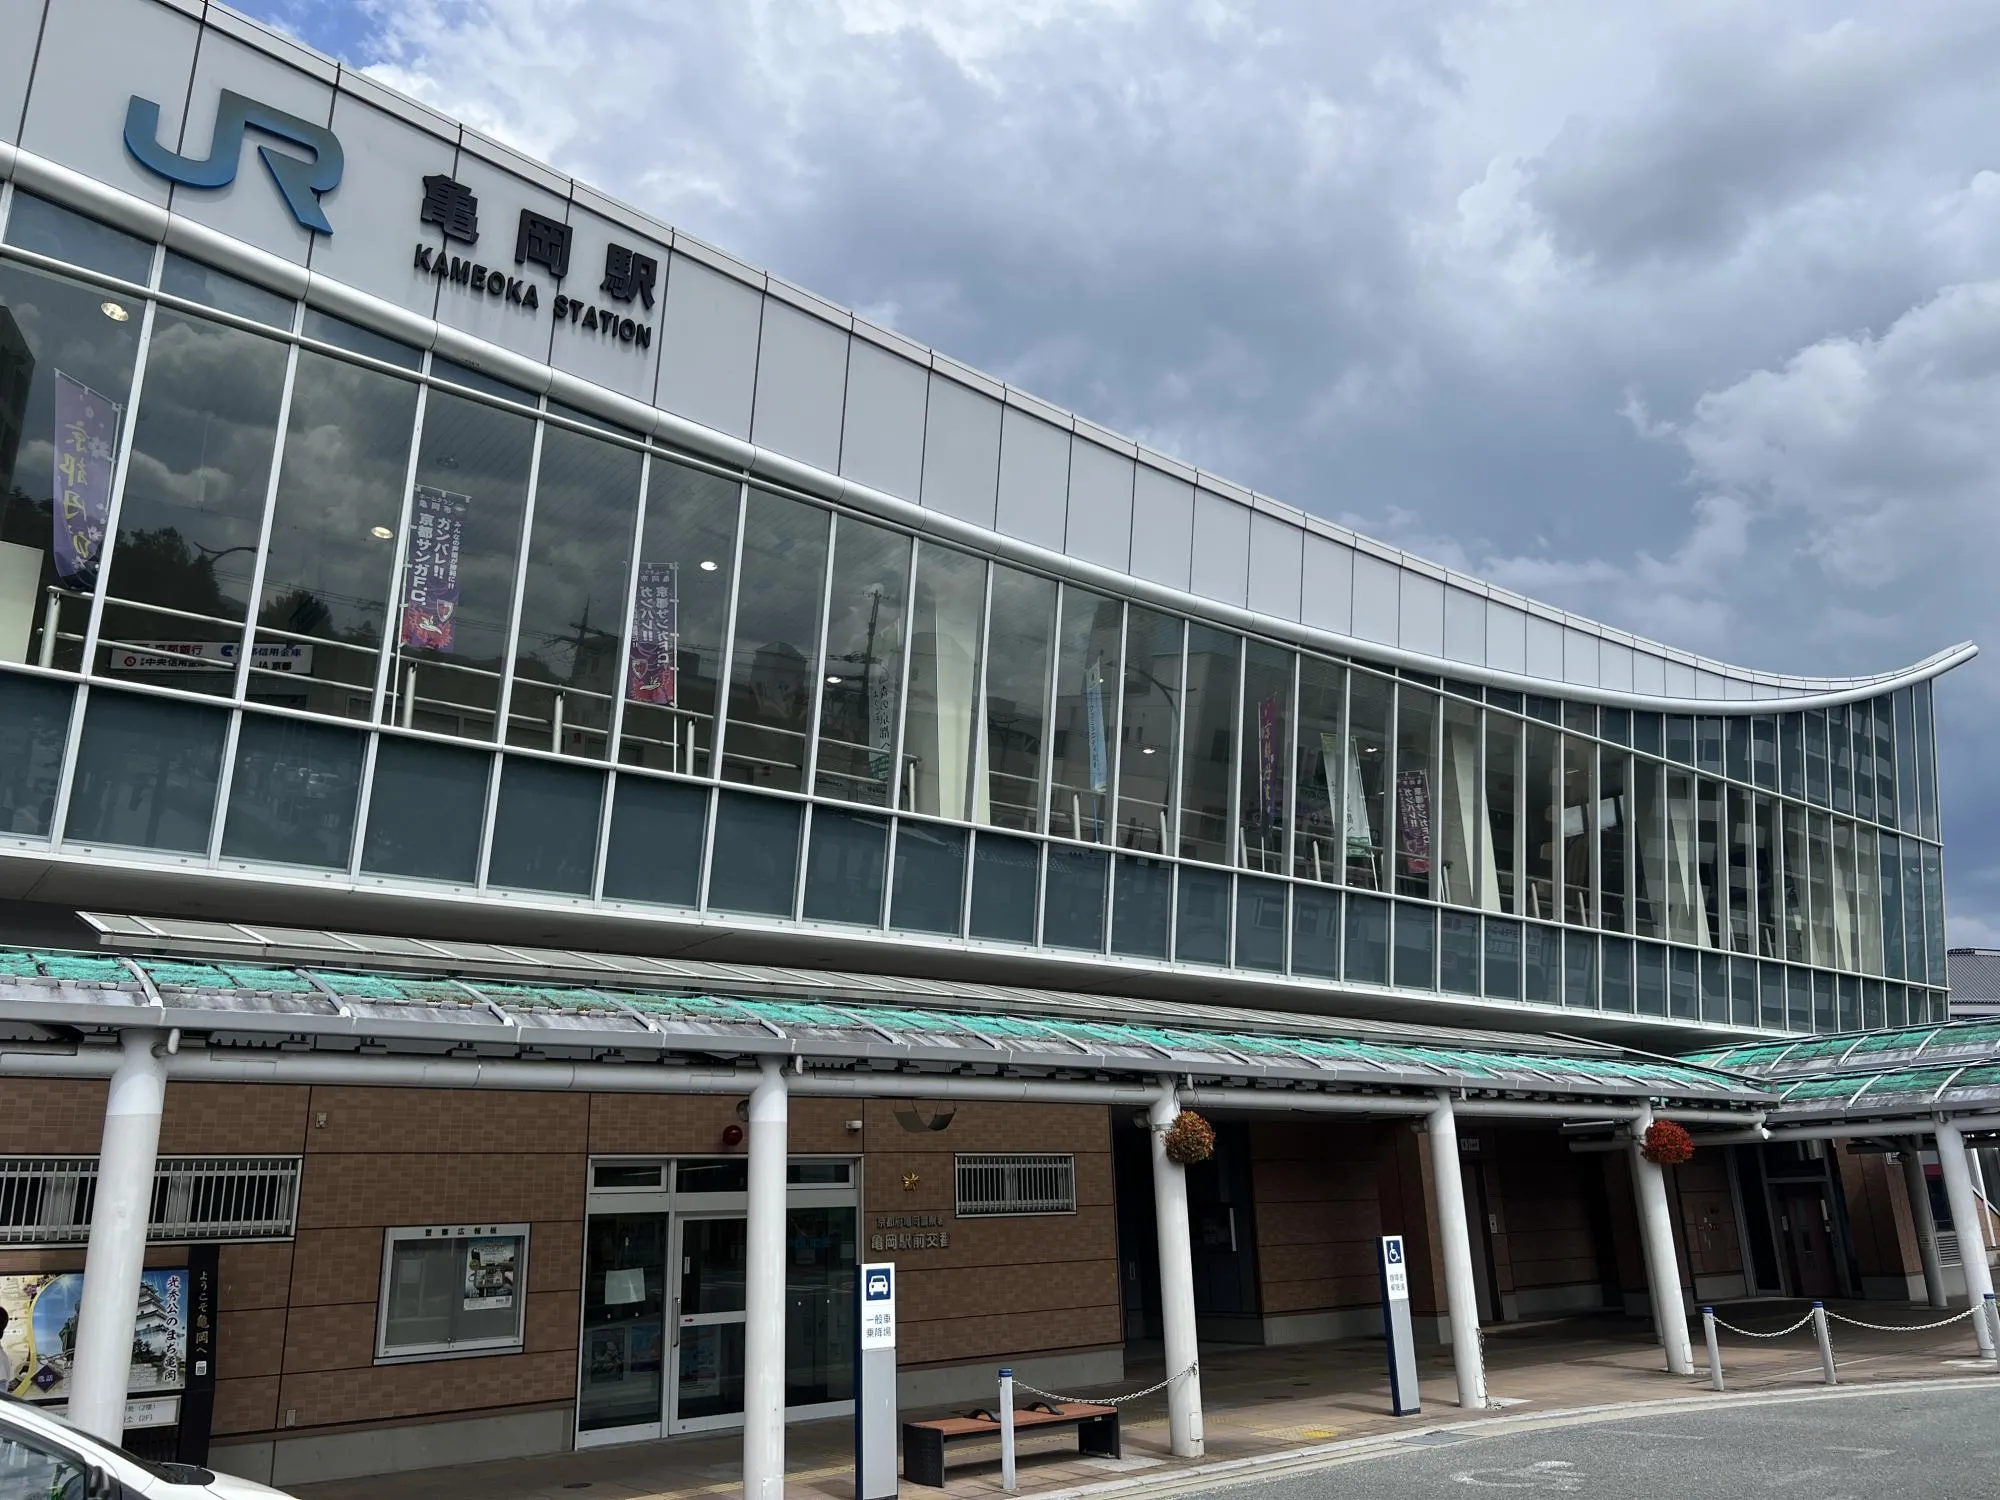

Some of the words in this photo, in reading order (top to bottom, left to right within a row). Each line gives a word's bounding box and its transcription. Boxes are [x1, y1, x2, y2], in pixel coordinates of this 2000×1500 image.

[123, 88, 345, 236] JR
[420, 174, 658, 309] 亀岡駅
[413, 243, 540, 310] KAMEOKA
[552, 294, 652, 349] STATION
[410, 512, 435, 606] 京都サンガF.C.
[433, 517, 452, 580] ガンバレ!!
[871, 1231, 950, 1251] 亀岡駅前交番
[163, 1275, 181, 1382] 光秀公のまち亀岡
[195, 1271, 210, 1354] ようこそ亀岡へ
[866, 1314, 891, 1325] 一般車
[866, 1327, 891, 1338] 乗降場
